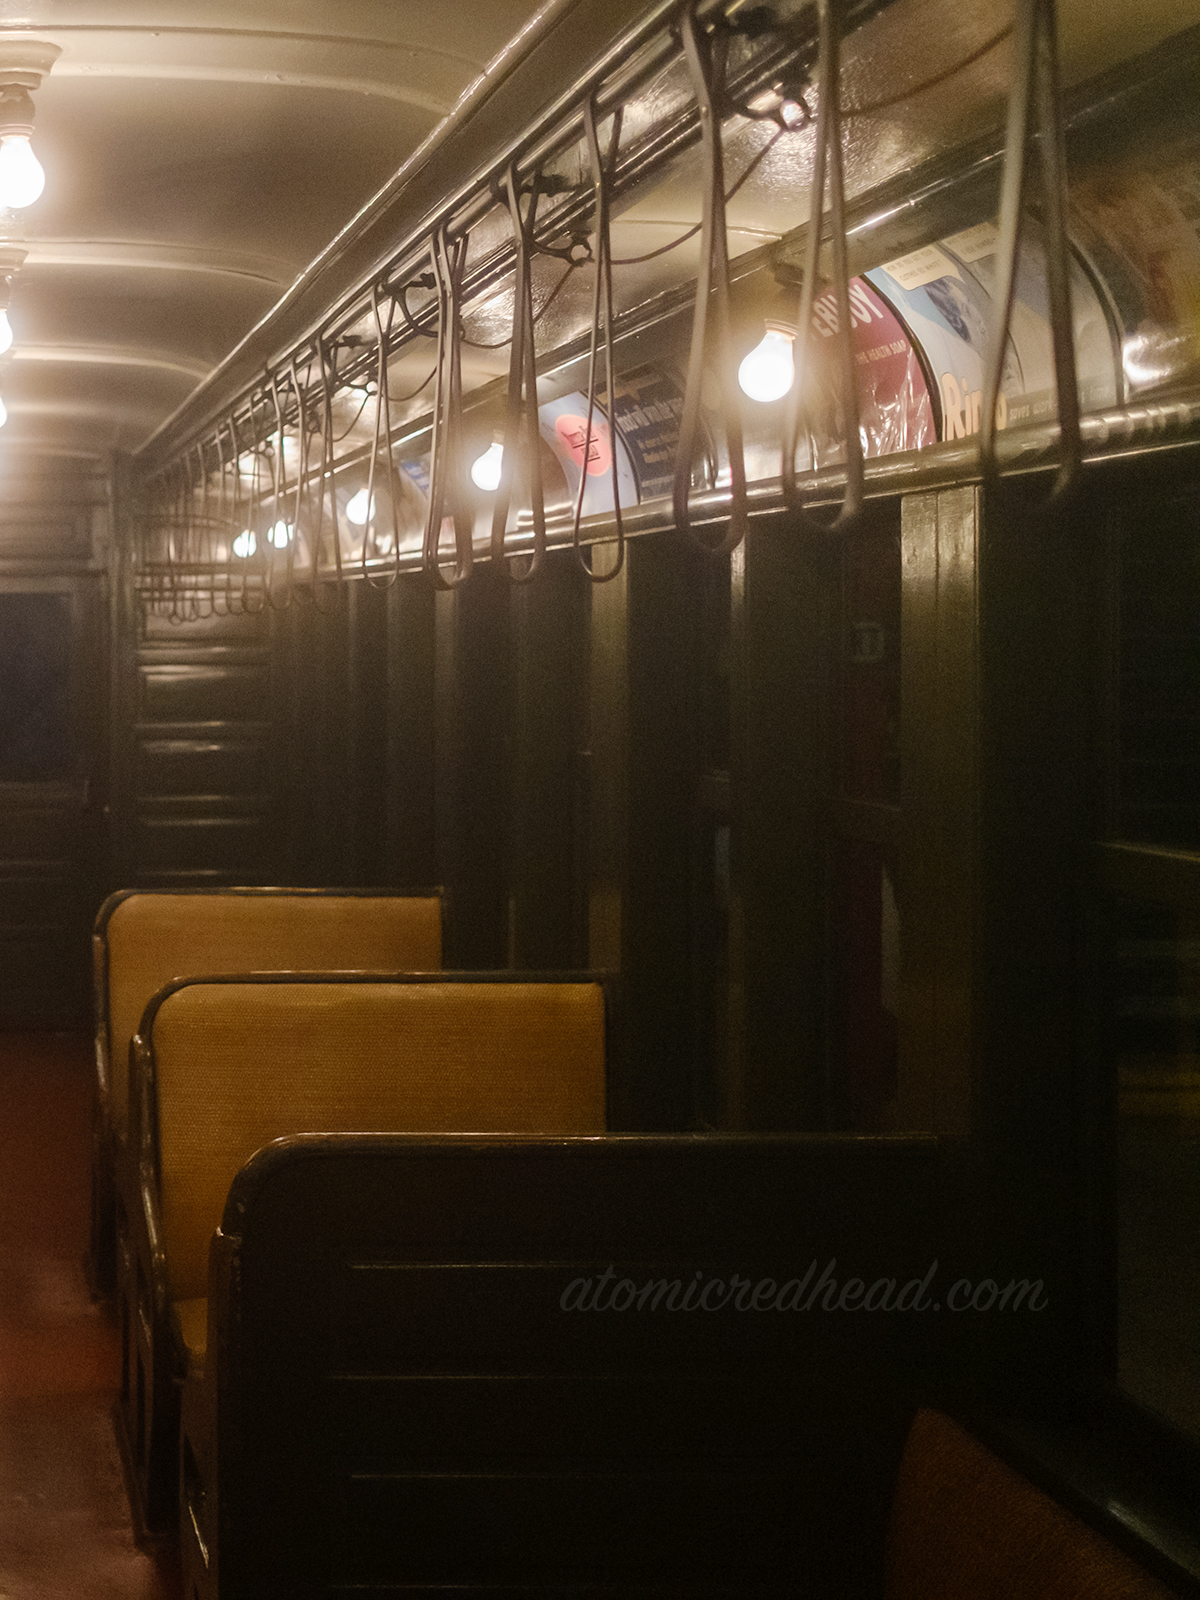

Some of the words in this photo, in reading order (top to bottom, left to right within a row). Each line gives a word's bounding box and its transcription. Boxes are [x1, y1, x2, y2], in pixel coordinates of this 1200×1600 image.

[868, 344, 893, 362] HEALTH
[890, 339, 907, 355] SOAP
[941, 372, 1007, 441] Rino
